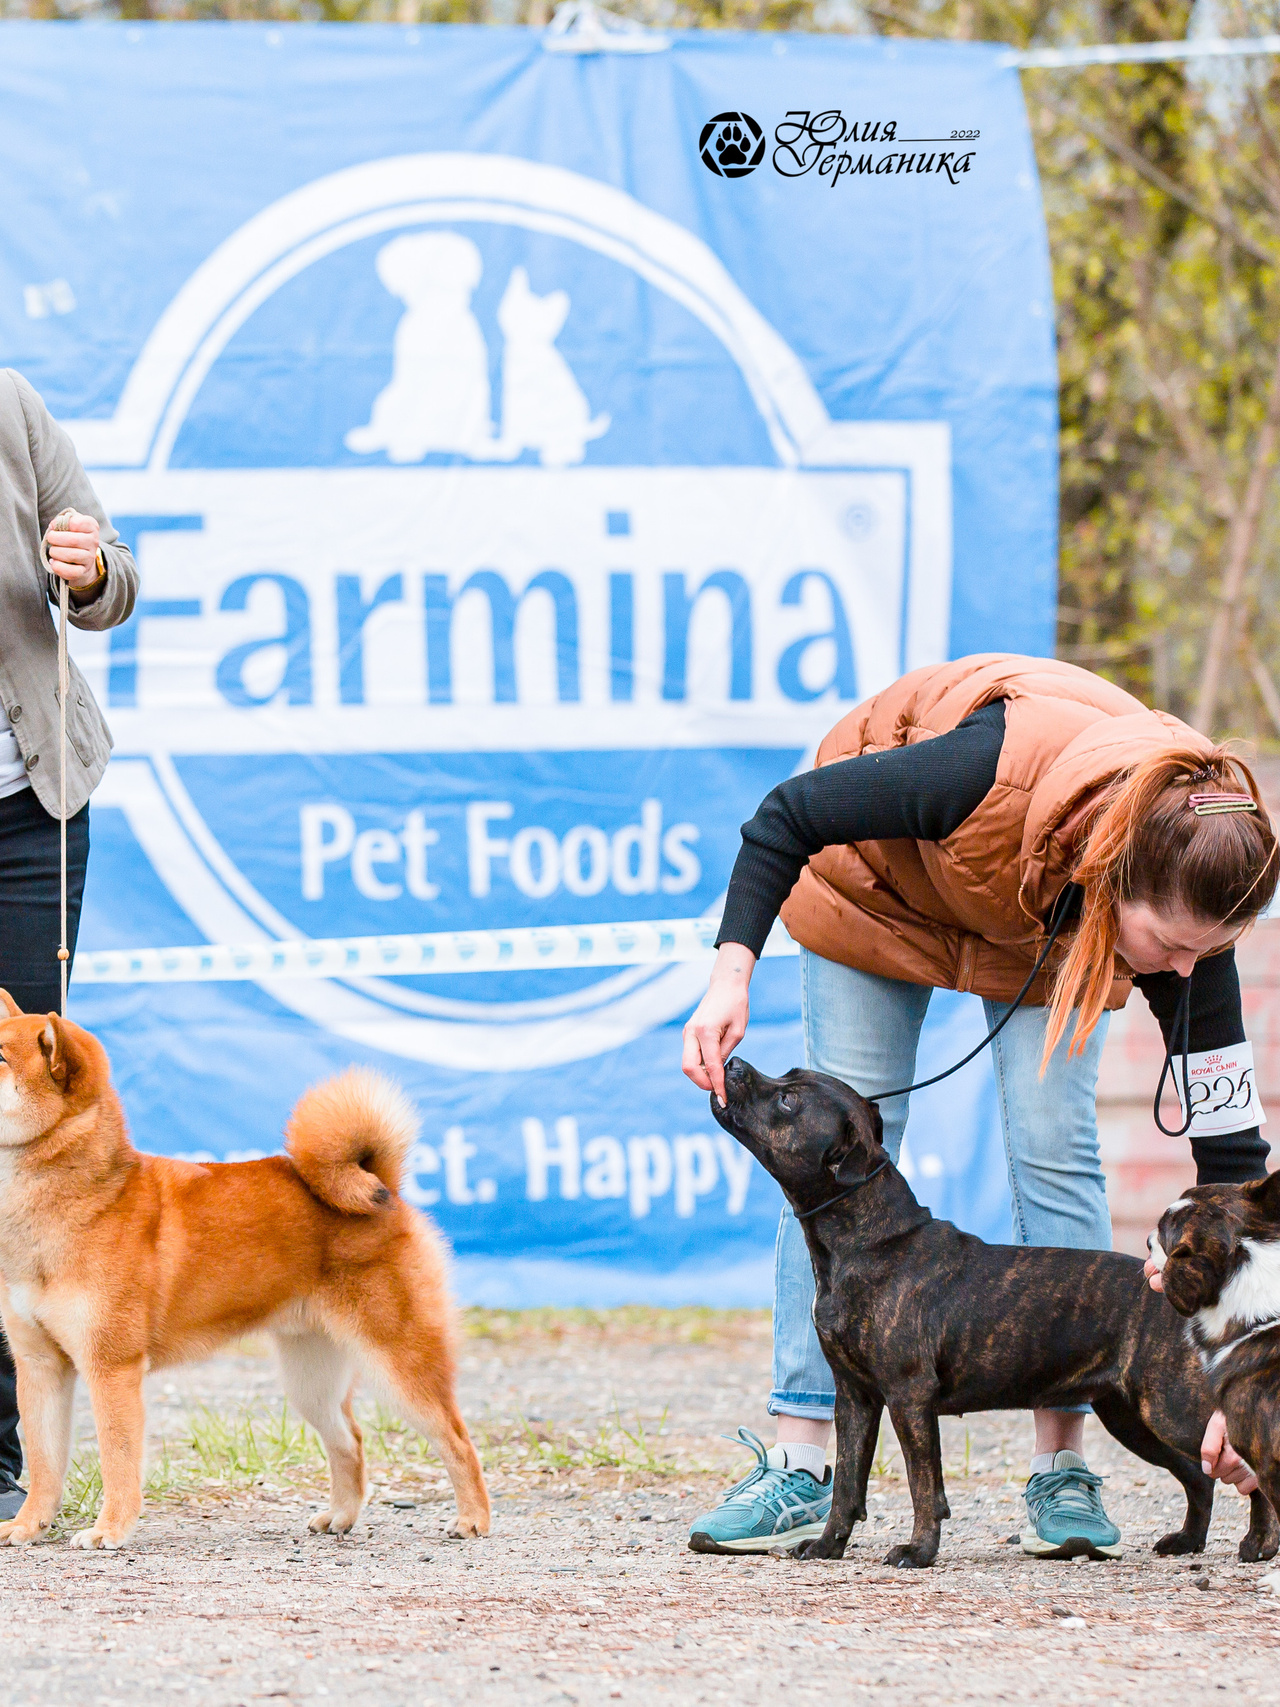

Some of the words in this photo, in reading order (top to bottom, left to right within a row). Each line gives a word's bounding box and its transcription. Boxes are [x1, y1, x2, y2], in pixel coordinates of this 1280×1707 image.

[107, 510, 859, 711] Farmina
[299, 802, 441, 902] Pet
[465, 798, 703, 900] Foods
[1188, 1068, 1253, 1118] 225
[1191, 1064, 1214, 1076] ROYAL
[1215, 1061, 1238, 1072] CANIN
[400, 1125, 497, 1205] et.
[521, 1115, 753, 1219] Happy
